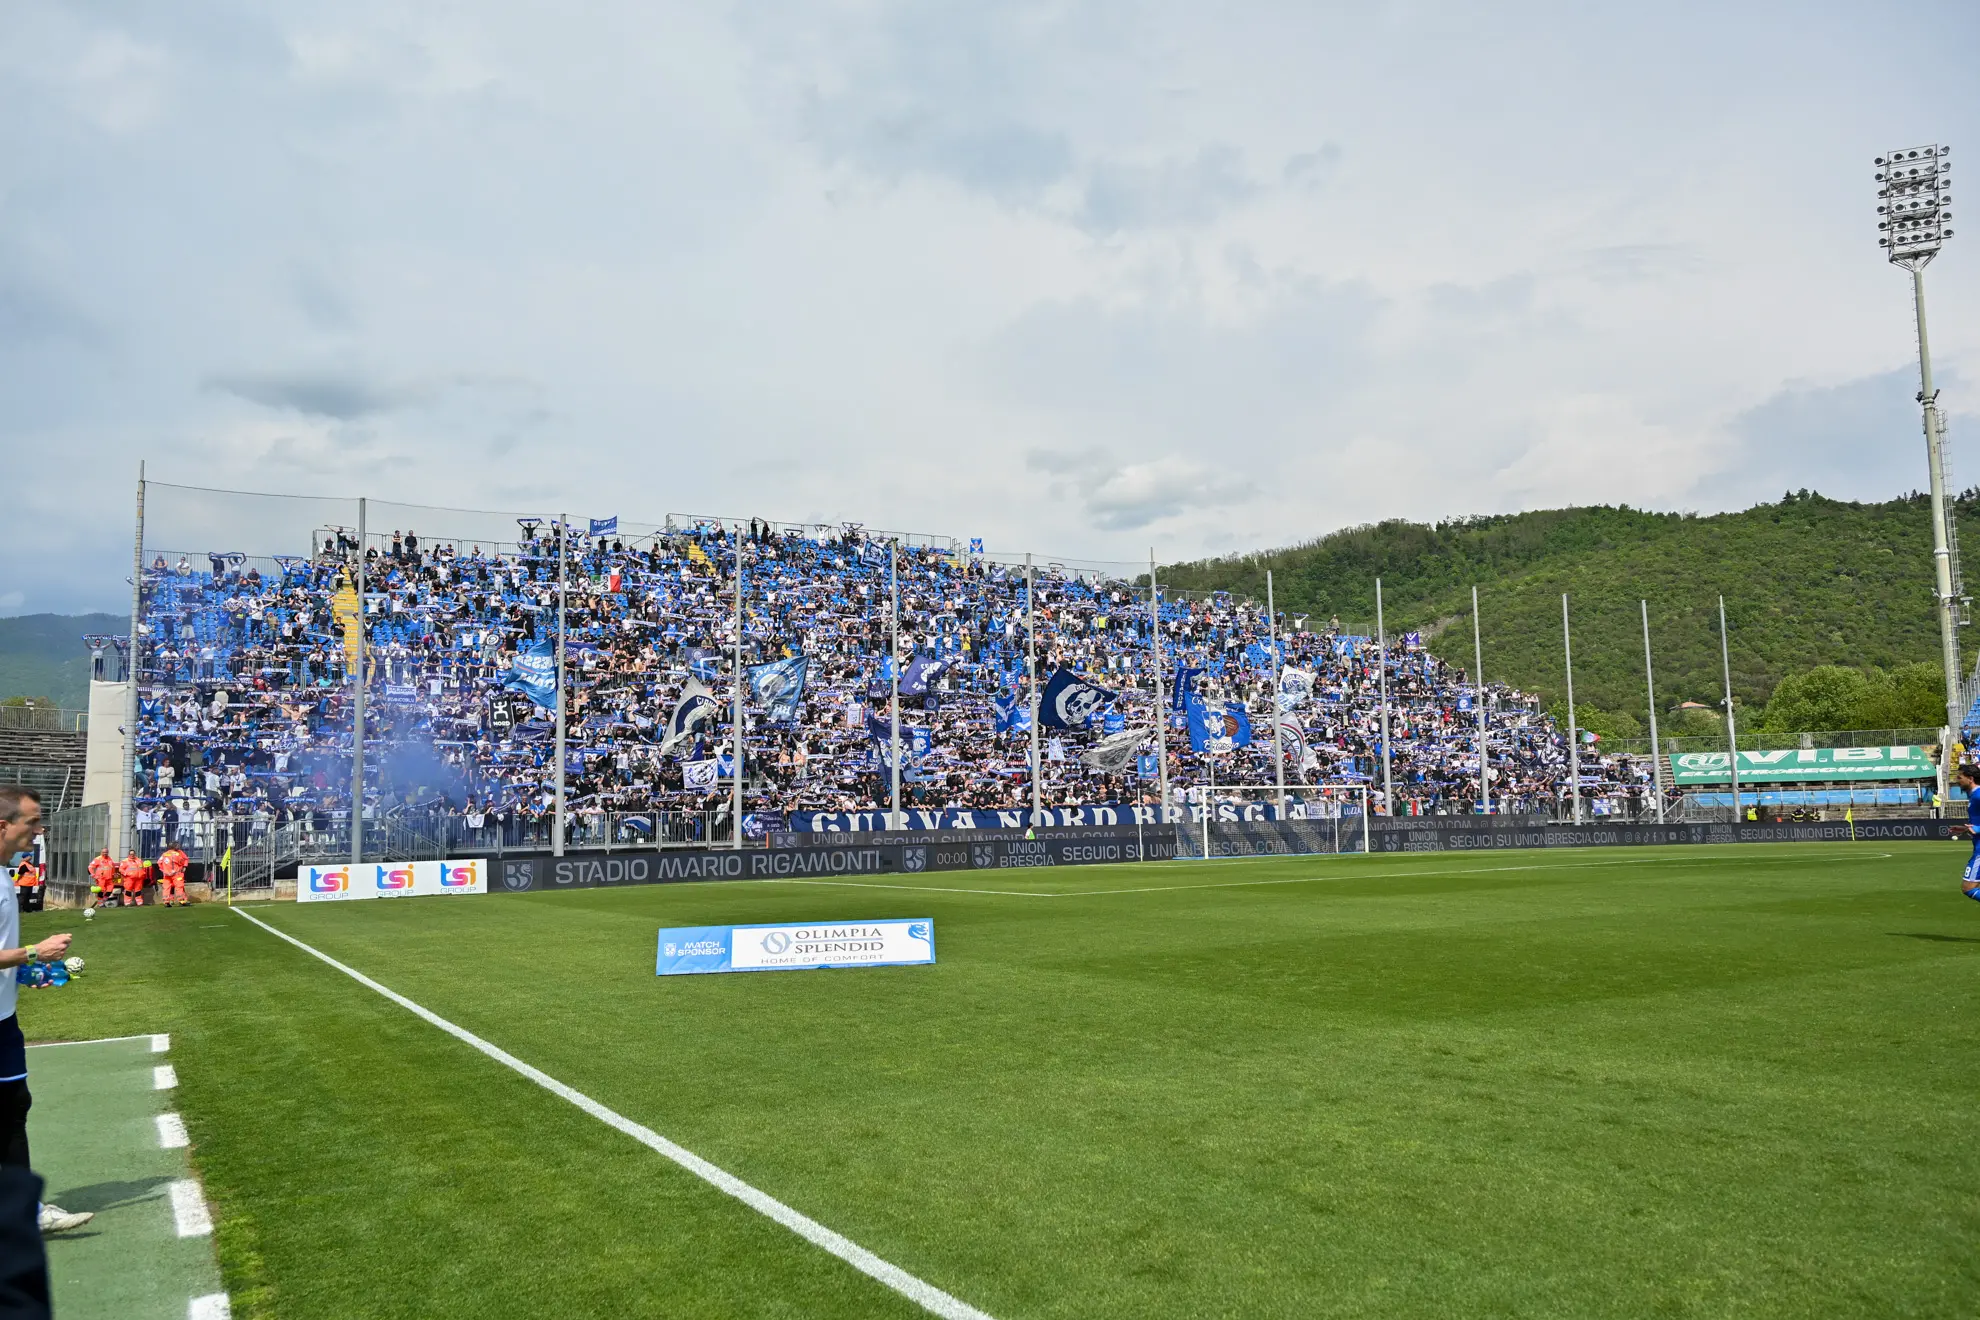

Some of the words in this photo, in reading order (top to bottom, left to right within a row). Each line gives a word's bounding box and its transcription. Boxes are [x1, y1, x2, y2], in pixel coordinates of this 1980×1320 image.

[996, 807, 1119, 829] NORD
[812, 832, 854, 845] UNION
[1408, 831, 1438, 842] UNION
[1740, 827, 1774, 840] SEGUICI
[1776, 827, 1789, 840] SU
[1790, 825, 1928, 839] UNIONBRESCIA.COM
[1449, 834, 1493, 848] SEGUICI
[1496, 833, 1512, 847] SU
[1515, 831, 1618, 846] UNIONBRESCIA.COM
[1007, 841, 1046, 854] UNION
[1062, 845, 1120, 862] SEGUICI
[1125, 843, 1145, 860] SU
[1403, 842, 1445, 852] BRESCIA
[936, 851, 968, 865] 00:00
[1000, 854, 1055, 868] BRESCIA
[555, 858, 649, 884] STADIO
[657, 855, 743, 879] MARIO
[751, 850, 881, 875] RIGAMONTI
[1964, 866, 1972, 878] 8
[310, 866, 349, 893] tsi
[376, 863, 415, 890] tsi
[440, 861, 477, 887] tsi
[375, 889, 415, 897] GROUP
[440, 886, 477, 894] GROUP
[309, 893, 349, 901] GROUP
[795, 928, 883, 940] OLIMPIA
[684, 941, 720, 949] MATCH
[794, 941, 884, 954] SPLENDID
[677, 948, 726, 957] SPONSOR
[824, 954, 885, 962] COMFORT
